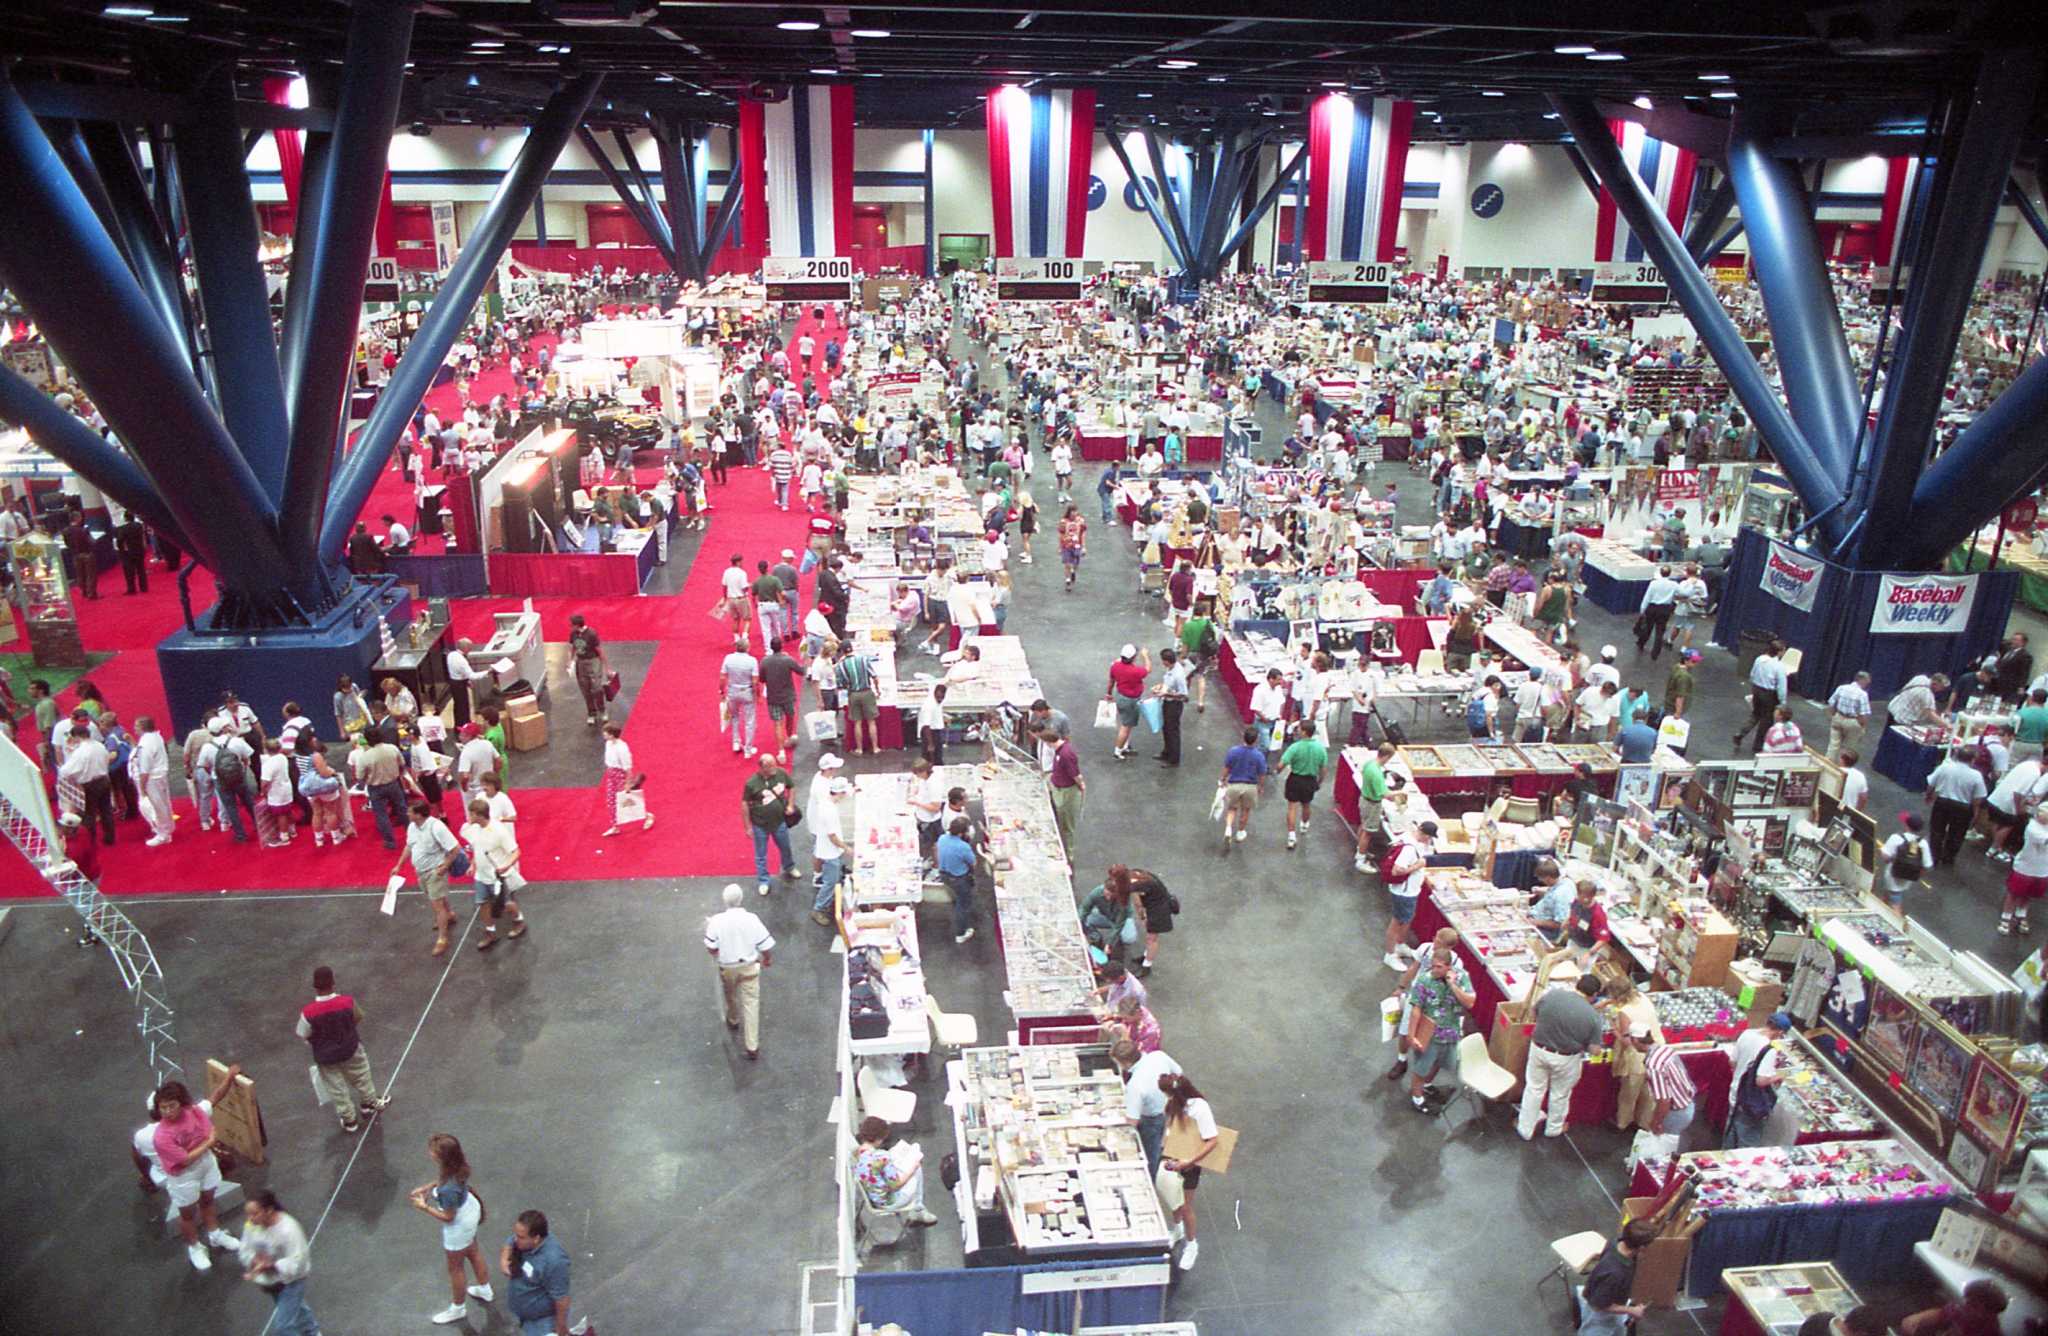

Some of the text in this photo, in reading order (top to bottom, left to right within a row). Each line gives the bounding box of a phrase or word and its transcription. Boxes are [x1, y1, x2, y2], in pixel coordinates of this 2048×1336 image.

[367, 262, 394, 280] 00
[807, 261, 849, 278] 2000
[1043, 262, 1074, 279] 100
[1354, 265, 1387, 282] 200
[1769, 552, 1814, 583] Baseball
[1887, 584, 1967, 604] Baseball
[1890, 604, 1954, 625] Weekly
